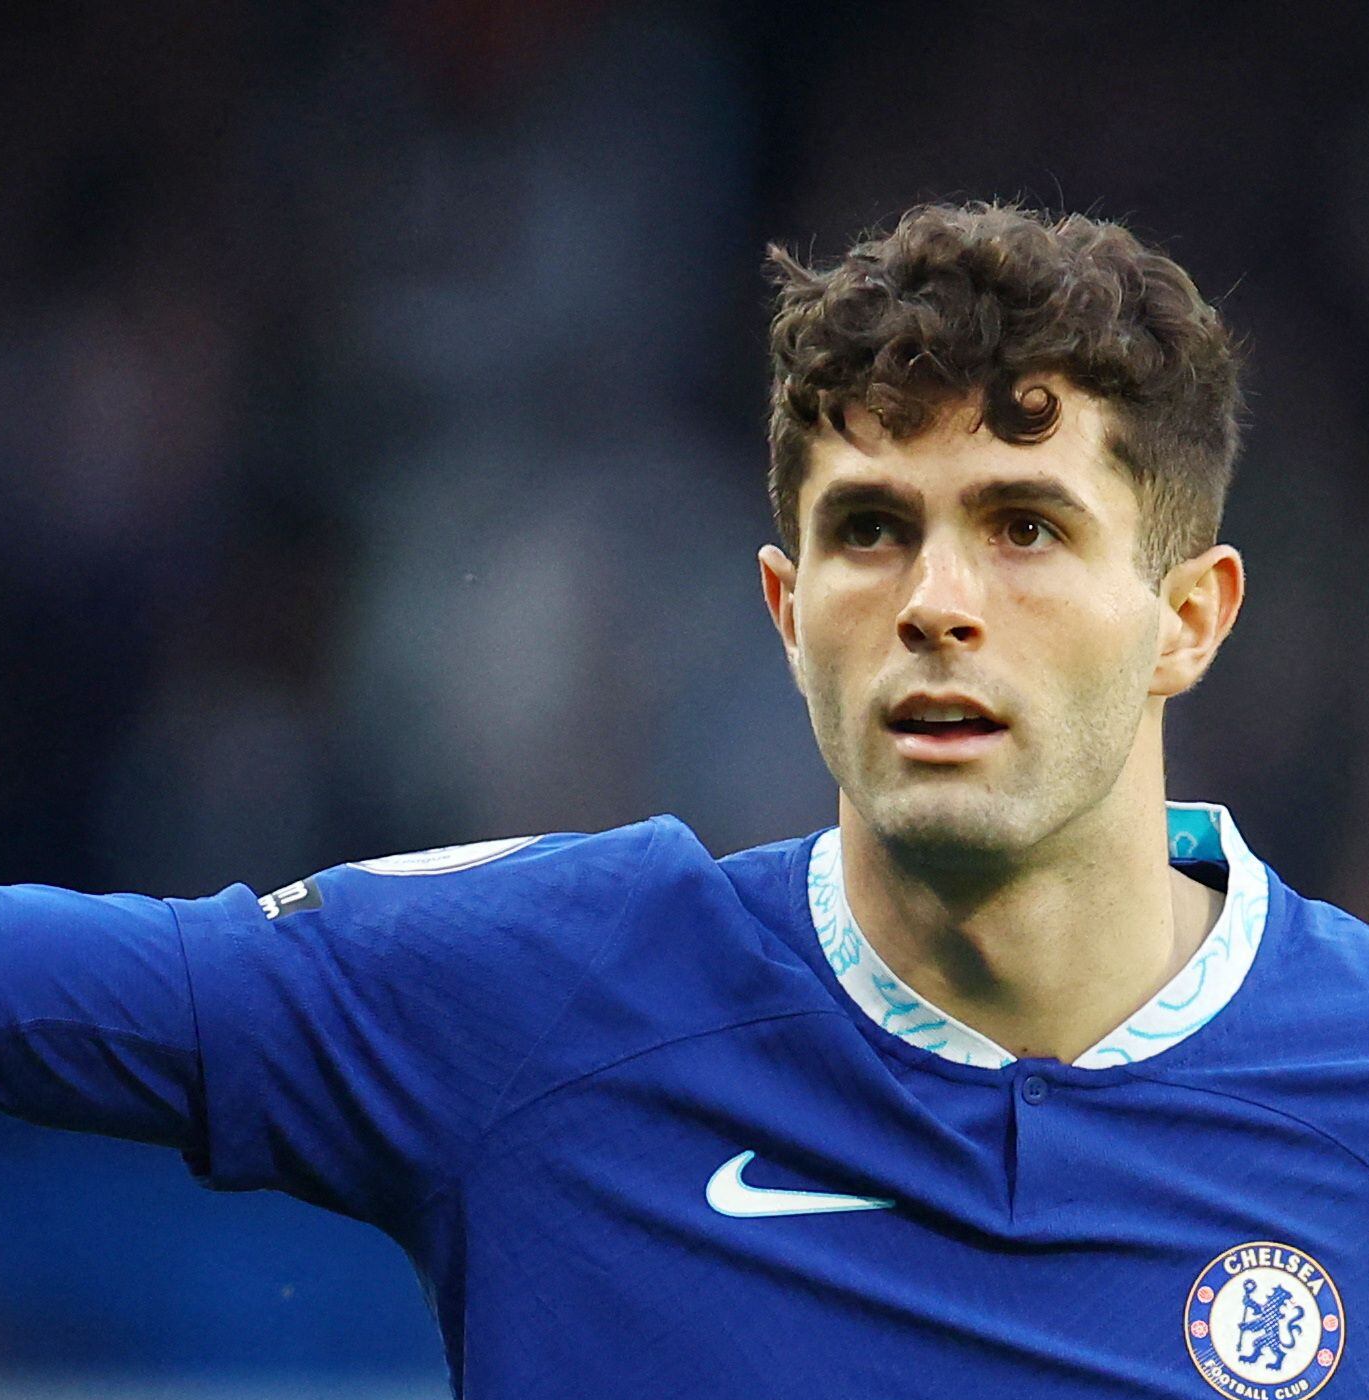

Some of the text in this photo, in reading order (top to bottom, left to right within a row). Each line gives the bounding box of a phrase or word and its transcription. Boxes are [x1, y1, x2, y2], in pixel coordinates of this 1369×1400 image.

[1223, 1247, 1325, 1296] CHELSEA
[1202, 1358, 1310, 1400] FOOTBALL CLUB
